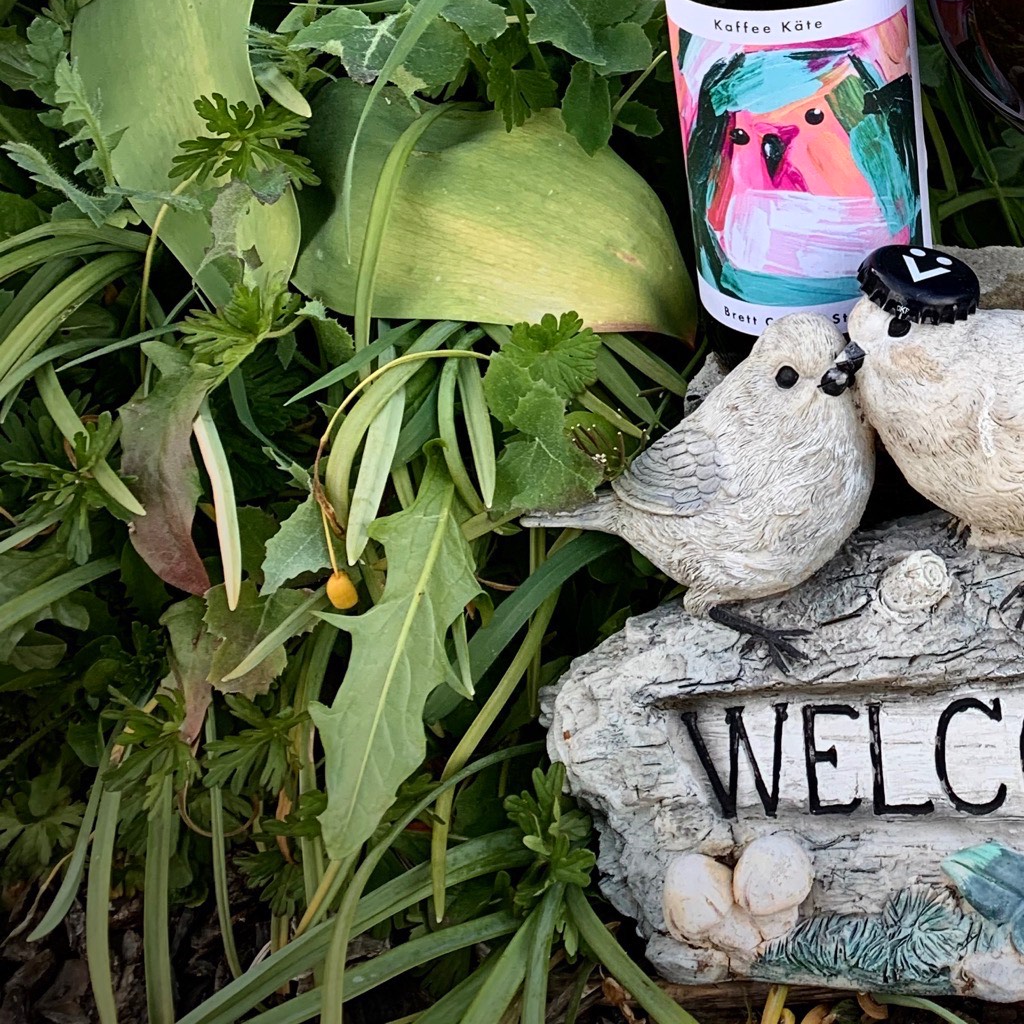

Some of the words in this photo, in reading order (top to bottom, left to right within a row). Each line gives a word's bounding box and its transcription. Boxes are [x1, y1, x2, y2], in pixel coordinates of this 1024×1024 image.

[713, 19, 771, 34] Kaffee
[781, 20, 823, 33] Käte
[723, 305, 758, 326] Brett
